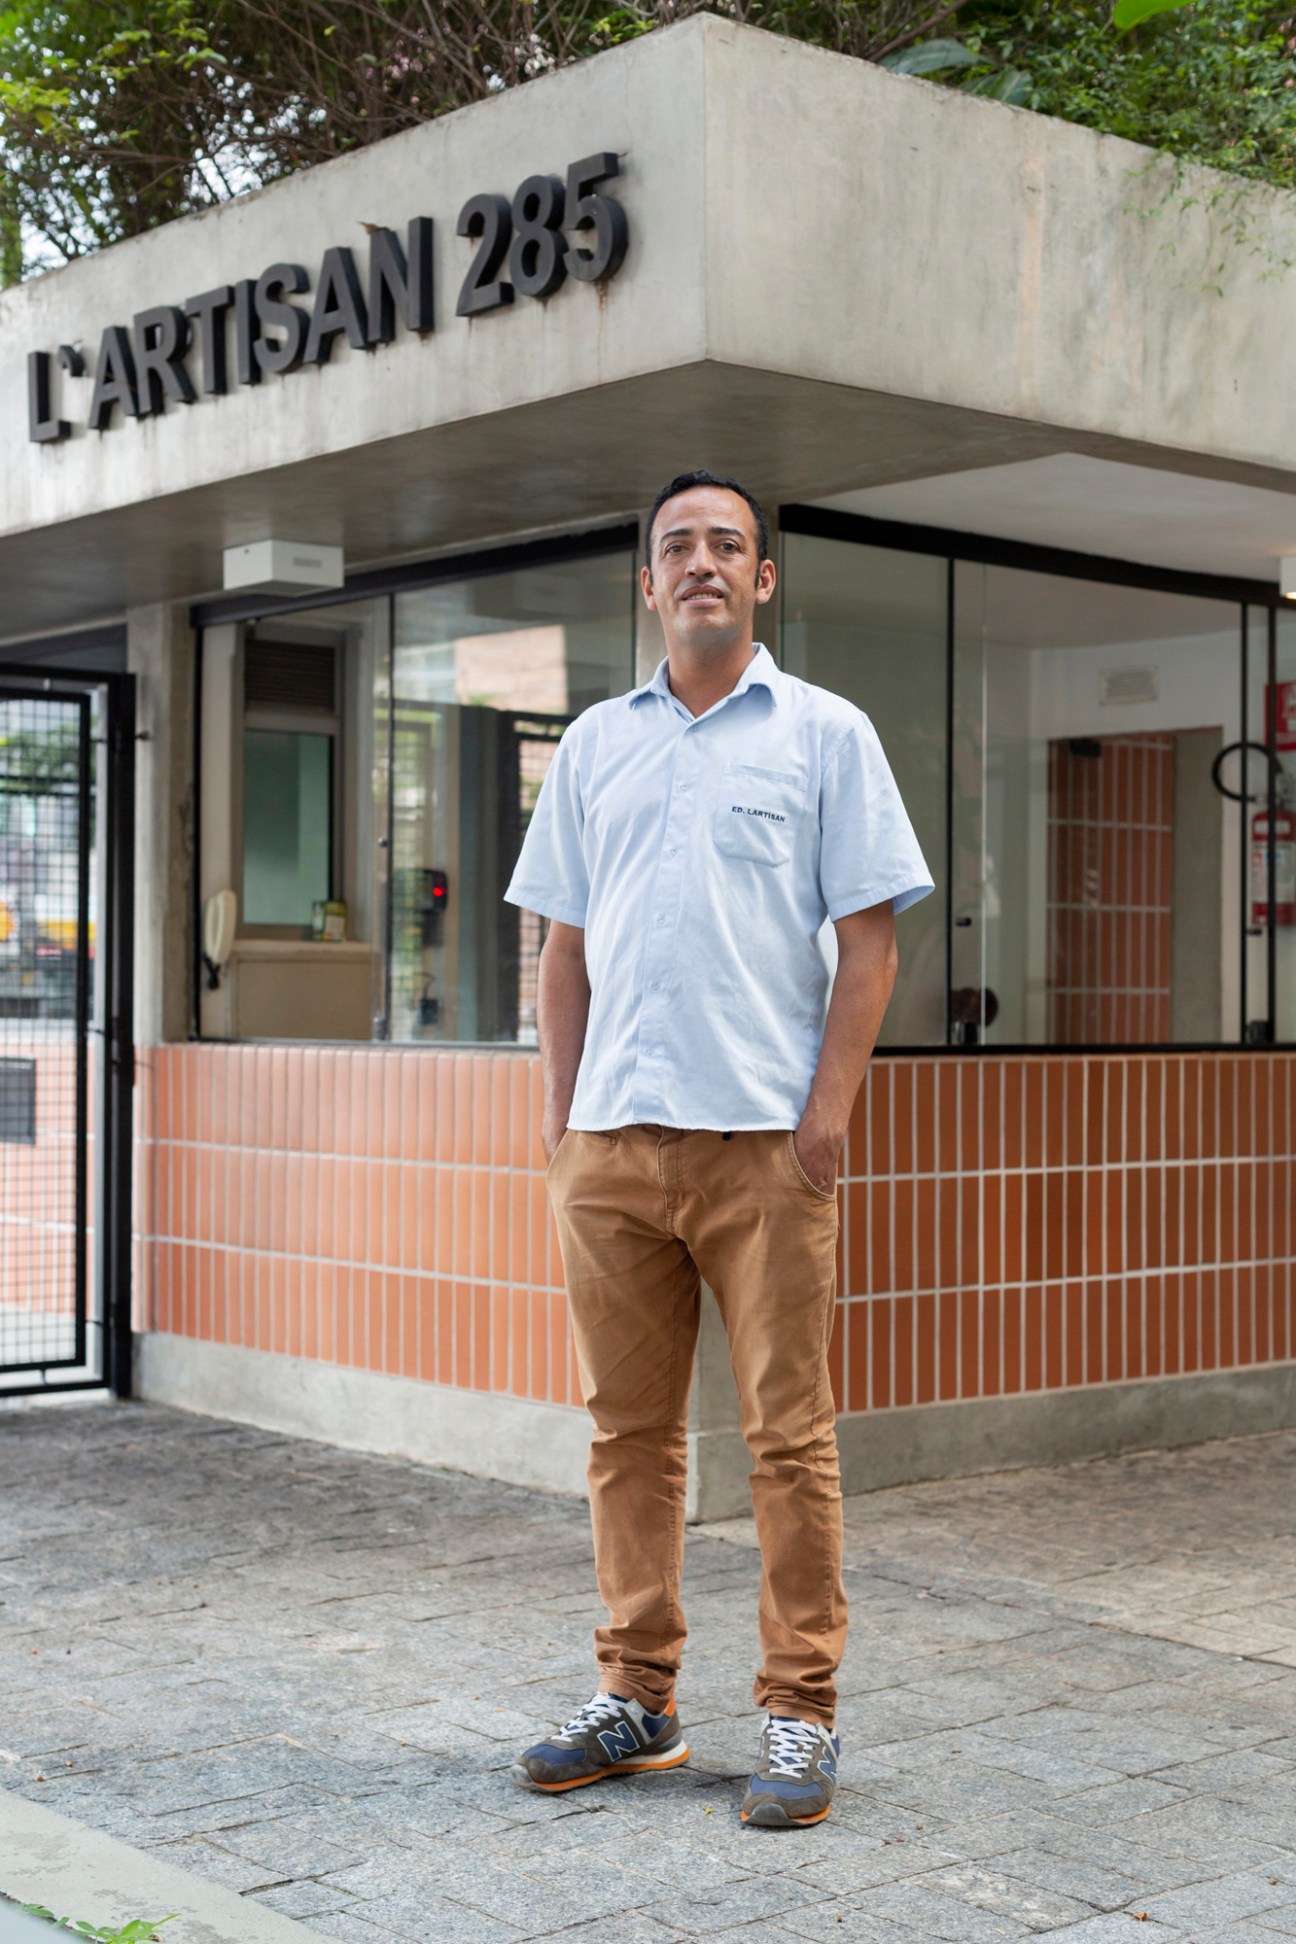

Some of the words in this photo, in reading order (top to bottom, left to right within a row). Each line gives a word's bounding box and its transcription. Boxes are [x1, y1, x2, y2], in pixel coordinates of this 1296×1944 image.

[27, 216, 434, 443] L'ARTISAN
[456, 152, 628, 317] 285
[731, 806, 745, 814] ED.
[598, 1720, 640, 1762] N
